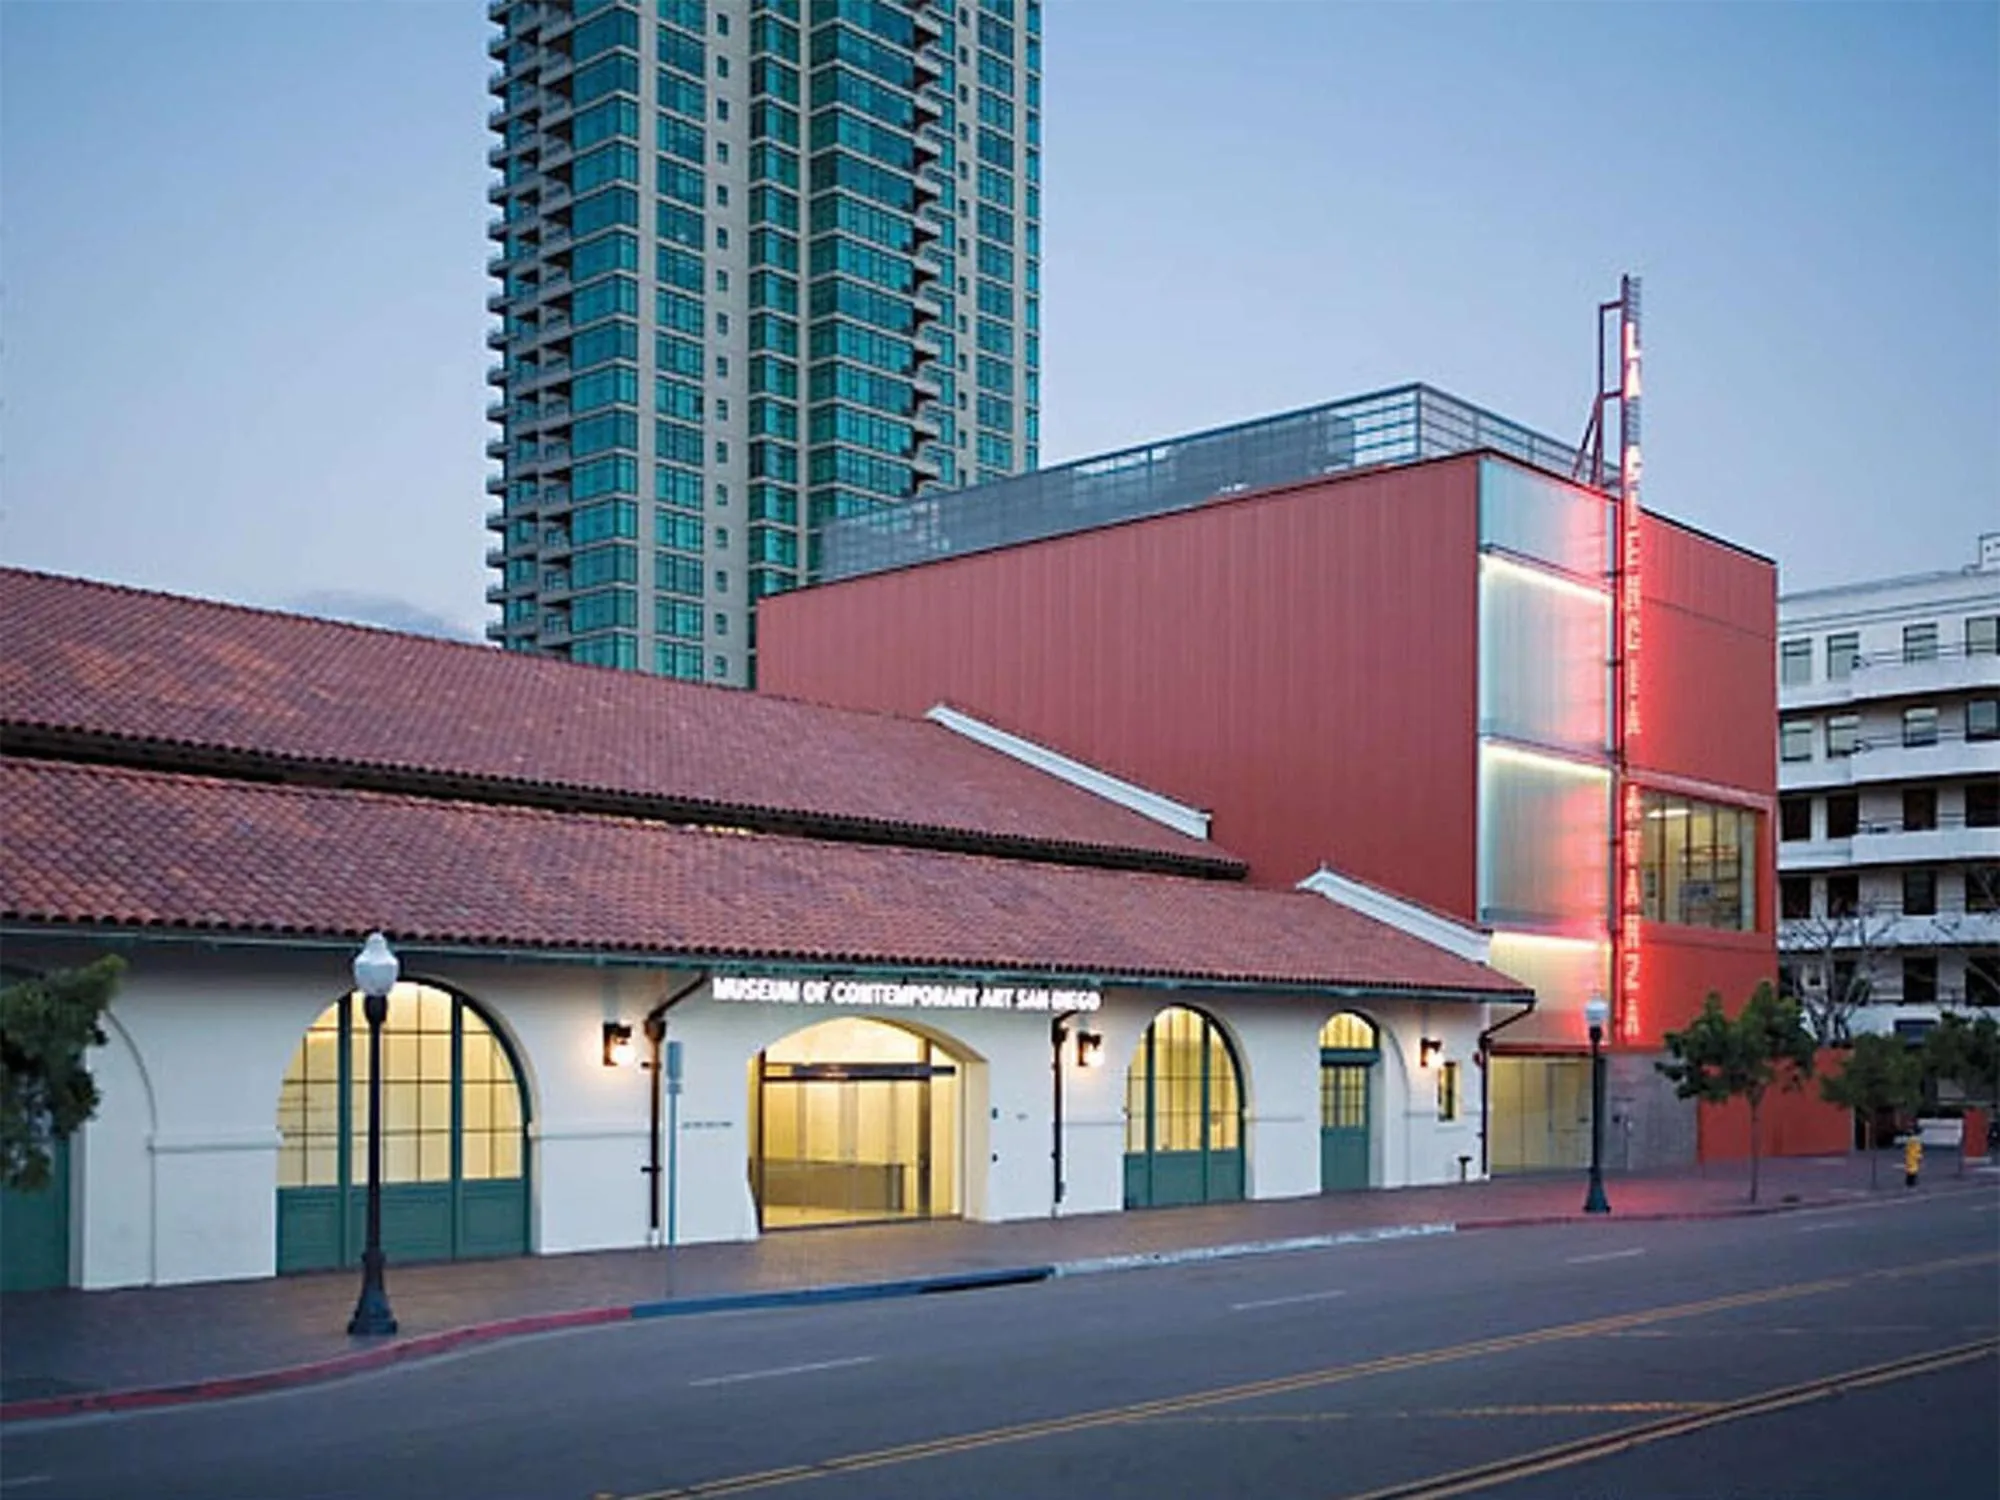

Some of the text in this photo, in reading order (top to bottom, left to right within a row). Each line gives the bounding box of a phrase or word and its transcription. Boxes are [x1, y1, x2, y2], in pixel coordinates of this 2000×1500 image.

[1624, 320, 1642, 398] LA
[712, 977, 1101, 1012] MUSEUM OF CONTEMPORARY ART SAN DIEGO
